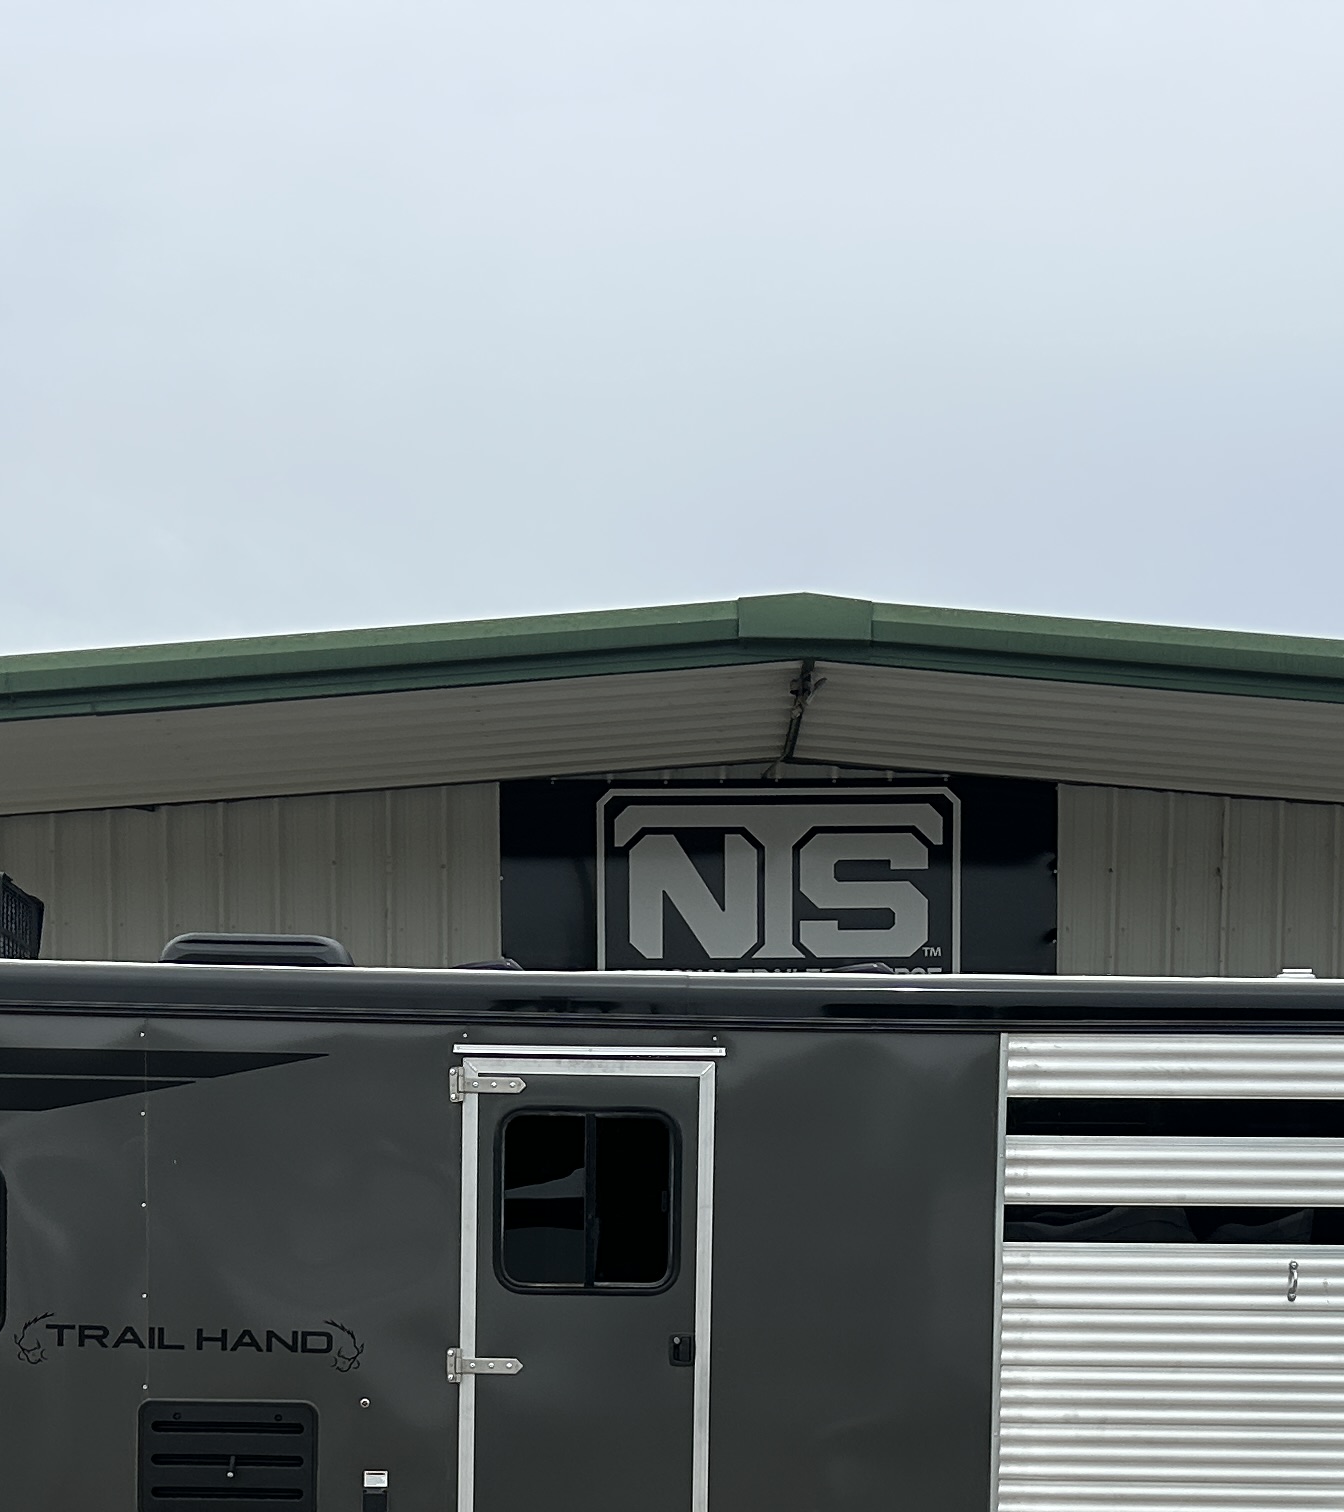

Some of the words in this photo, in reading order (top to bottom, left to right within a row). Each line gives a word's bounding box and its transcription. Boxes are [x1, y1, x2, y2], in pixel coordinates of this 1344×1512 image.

[614, 804, 943, 958] NTS
[922, 946, 942, 957] TM
[46, 1324, 185, 1350] TRAIL
[196, 1328, 334, 1354] HAND
